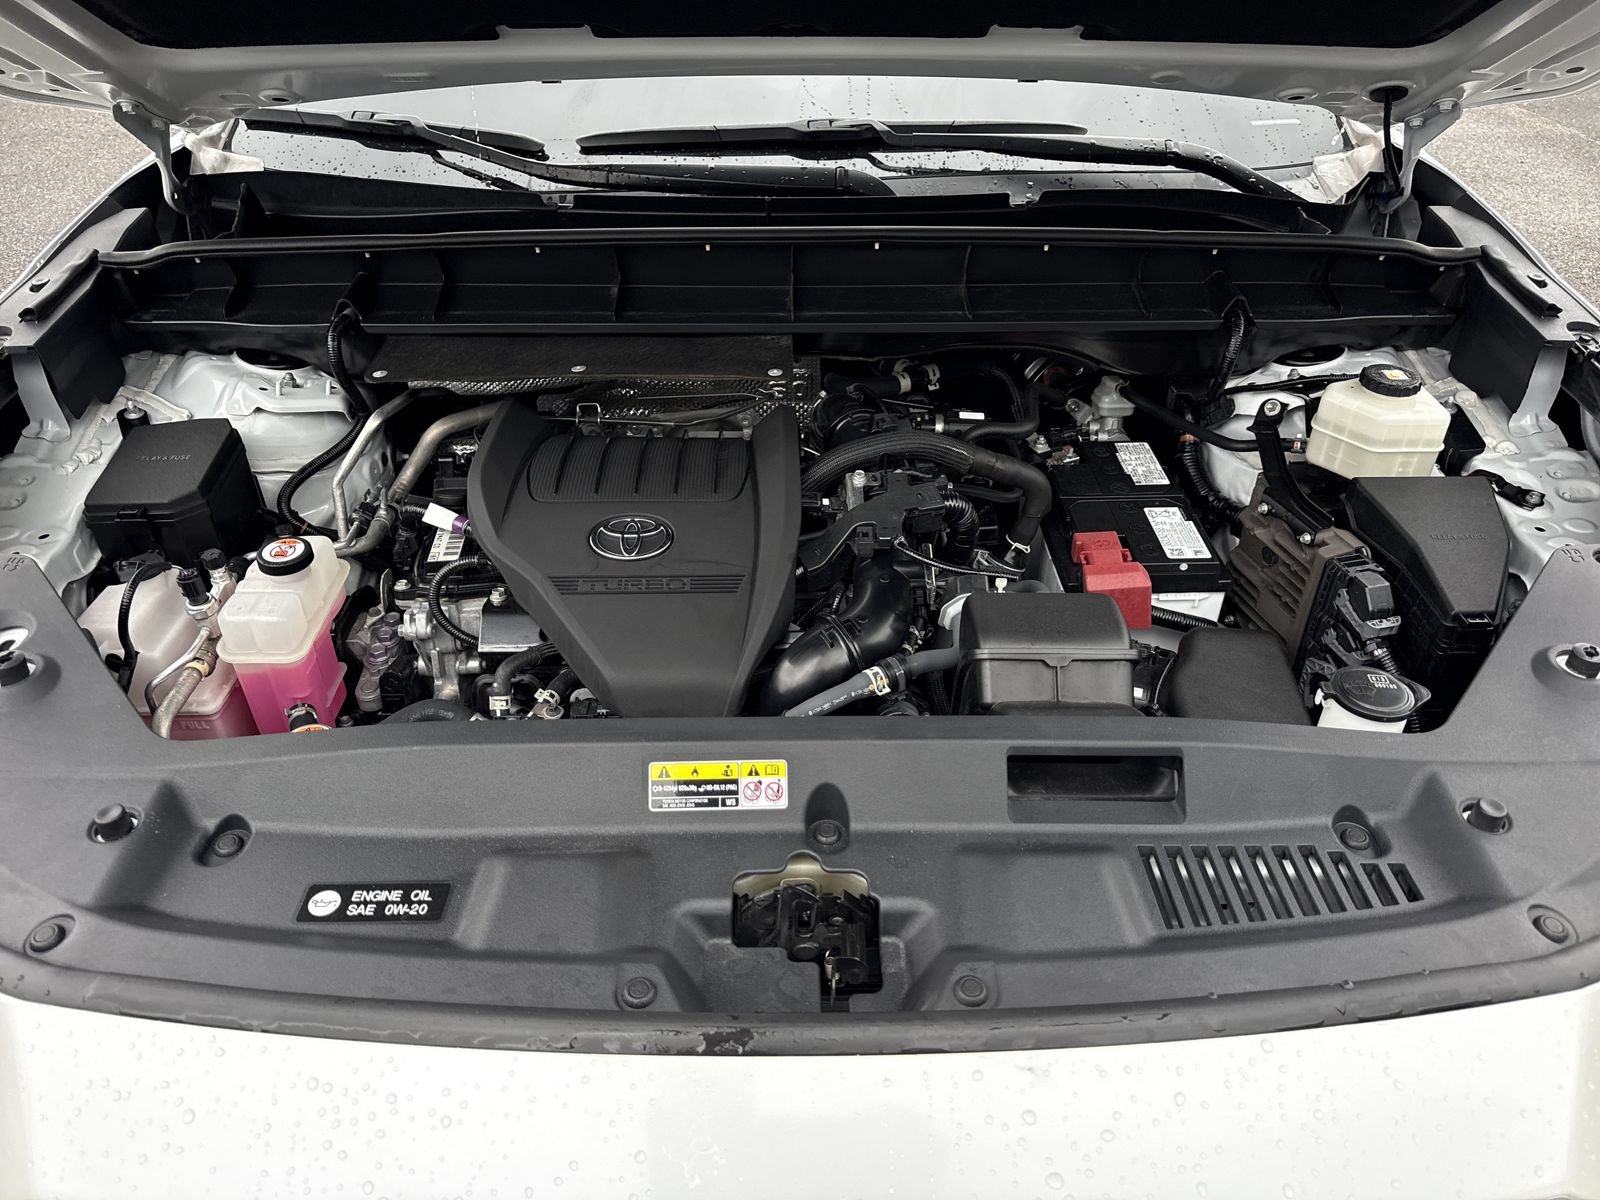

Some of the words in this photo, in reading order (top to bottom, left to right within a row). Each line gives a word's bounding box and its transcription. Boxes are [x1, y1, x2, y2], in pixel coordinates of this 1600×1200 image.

[581, 578, 688, 591] TURBO
[351, 889, 403, 902] ENGINE
[410, 889, 433, 901] OIL
[346, 904, 376, 916] SAE
[384, 903, 428, 915] 0W-20
